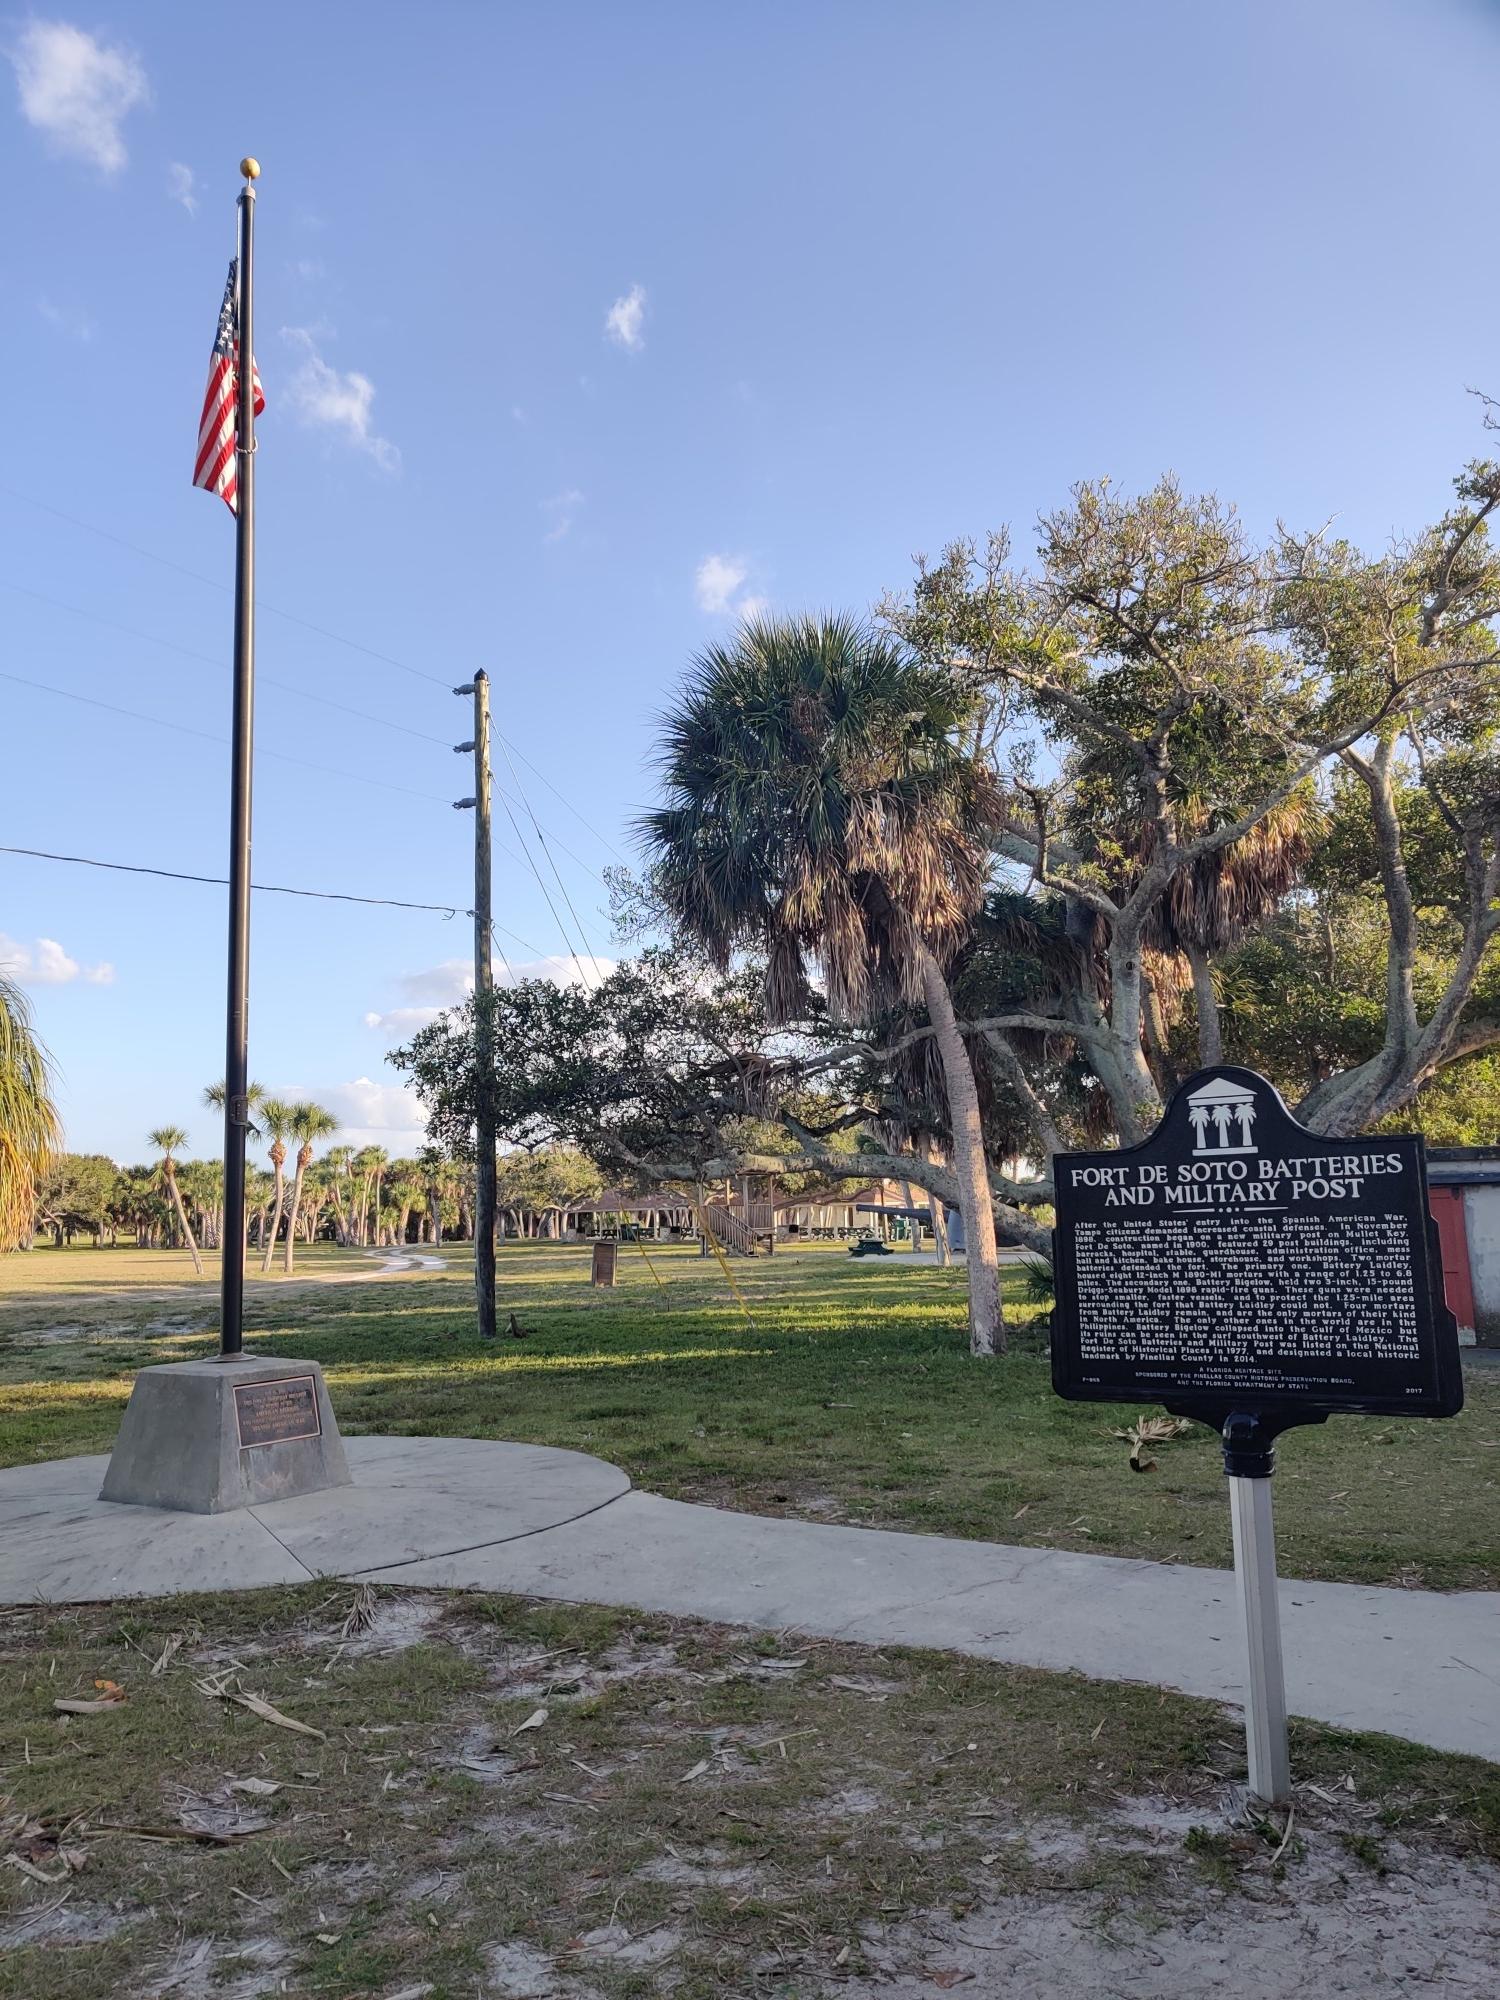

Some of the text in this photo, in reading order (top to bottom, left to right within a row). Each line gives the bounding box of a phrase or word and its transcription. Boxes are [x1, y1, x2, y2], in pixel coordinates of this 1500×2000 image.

[1071, 1153, 1403, 1187] FORT DE SOTO BATTERIES
[1104, 1178, 1364, 1207] AND MILITARY POST
[1282, 1216, 1320, 1224] Spanish
[1166, 1234, 1193, 1242] began
[1252, 1232, 1291, 1240] military
[1361, 1238, 1409, 1246] including
[1244, 1263, 1284, 1271] primary
[1322, 1262, 1361, 1270] Battery
[1269, 1294, 1306, 1302] protect
[1174, 1324, 1208, 1332] Bigelow
[1302, 1334, 1340, 1342] Battery
[1208, 1340, 1247, 1348] Military
[1080, 1345, 1115, 1353] Register
[1277, 1349, 1331, 1357] designated
